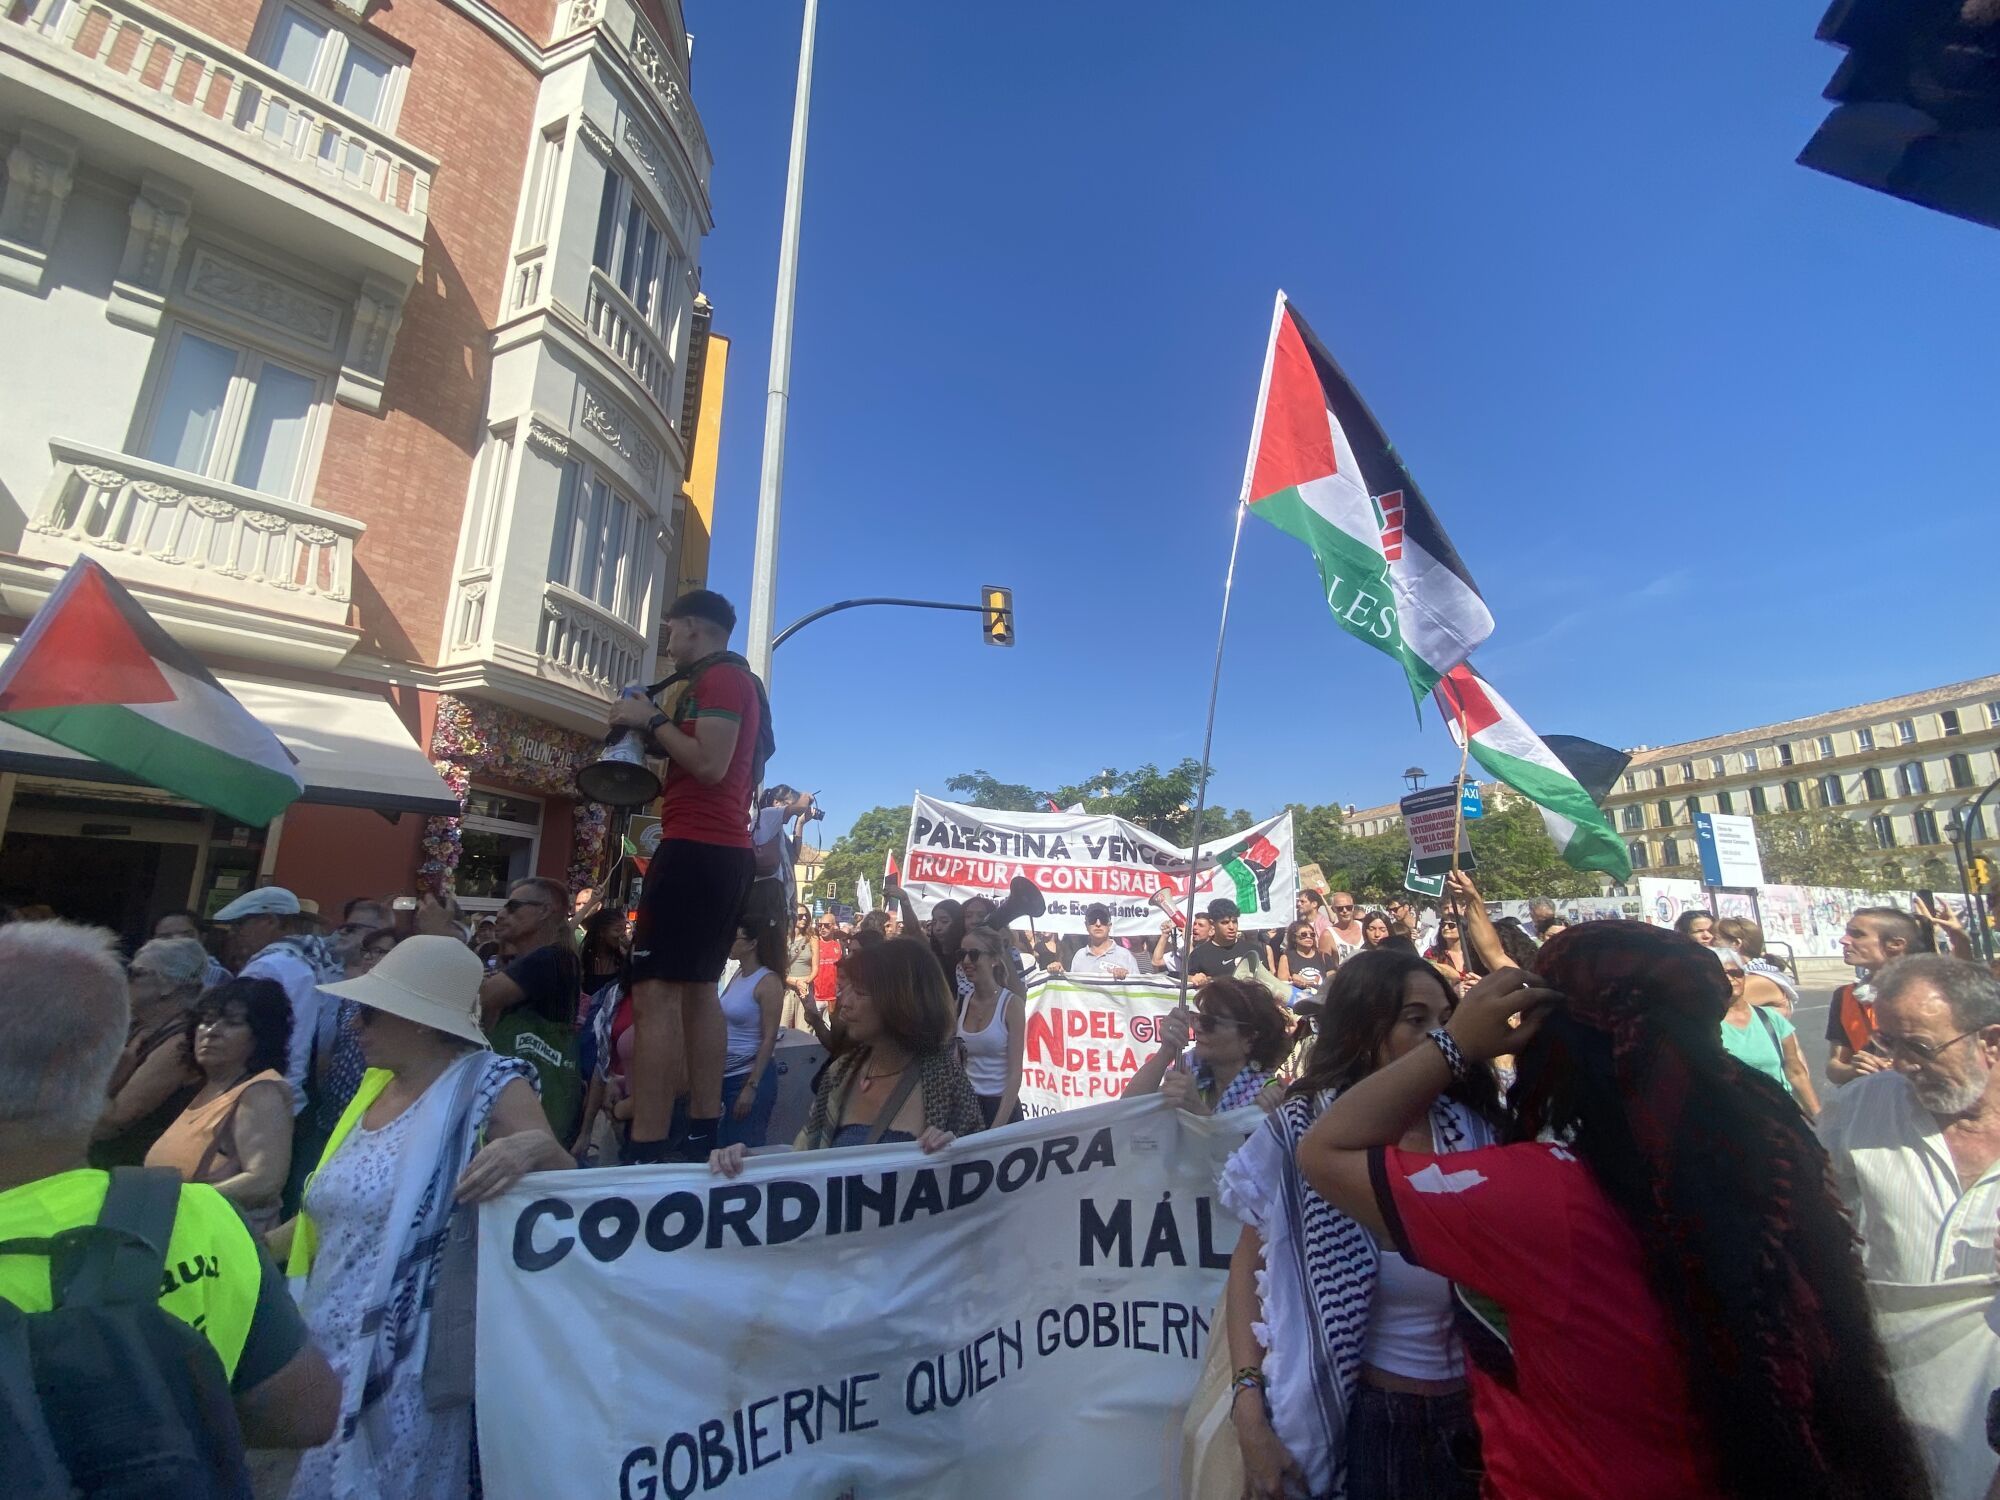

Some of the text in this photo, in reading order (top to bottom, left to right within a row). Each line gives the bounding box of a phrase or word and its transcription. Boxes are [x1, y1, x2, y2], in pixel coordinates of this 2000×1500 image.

[1410, 818, 1456, 836] INTERNACIONA
[1411, 809, 1454, 825] SOLIDARIDAD
[914, 816, 1072, 860] PALESTINA
[1437, 829, 1455, 841] CAUS
[1035, 866, 1093, 890] CON
[1101, 868, 1161, 894] ISRAEL
[1048, 901, 1067, 914] de
[1026, 1008, 1064, 1068] N
[1067, 1009, 1123, 1039] DEL
[1066, 1048, 1101, 1072] DE
[1107, 1047, 1138, 1072] LA
[1023, 1069, 1057, 1094] TRA
[1062, 1075, 1083, 1096] EL
[512, 1127, 1116, 1272] COORDINADORA
[1079, 1191, 1231, 1269] MÁL
[618, 1301, 1214, 1500] GOBIERNE QUIEN GOBIERN
